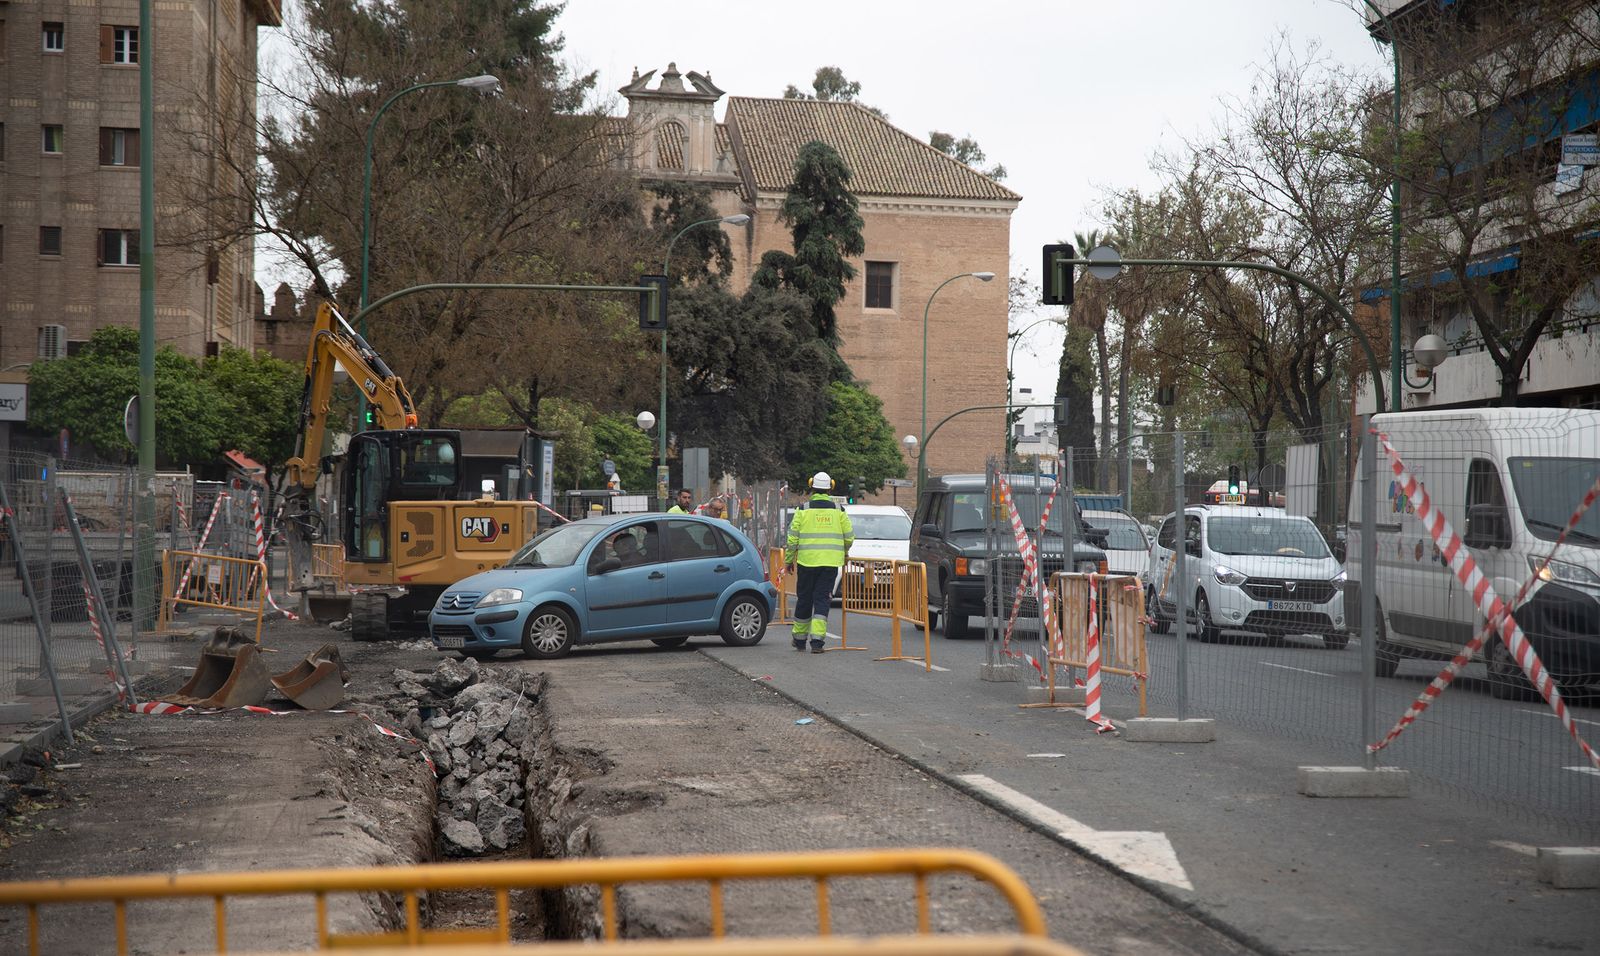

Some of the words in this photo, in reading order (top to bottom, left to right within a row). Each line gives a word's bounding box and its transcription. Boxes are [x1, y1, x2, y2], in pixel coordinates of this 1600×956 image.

[365, 378, 376, 393] CAT
[462, 517, 490, 537] CAT
[1273, 601, 1295, 611] 8672
[1296, 602, 1312, 611] KTD
